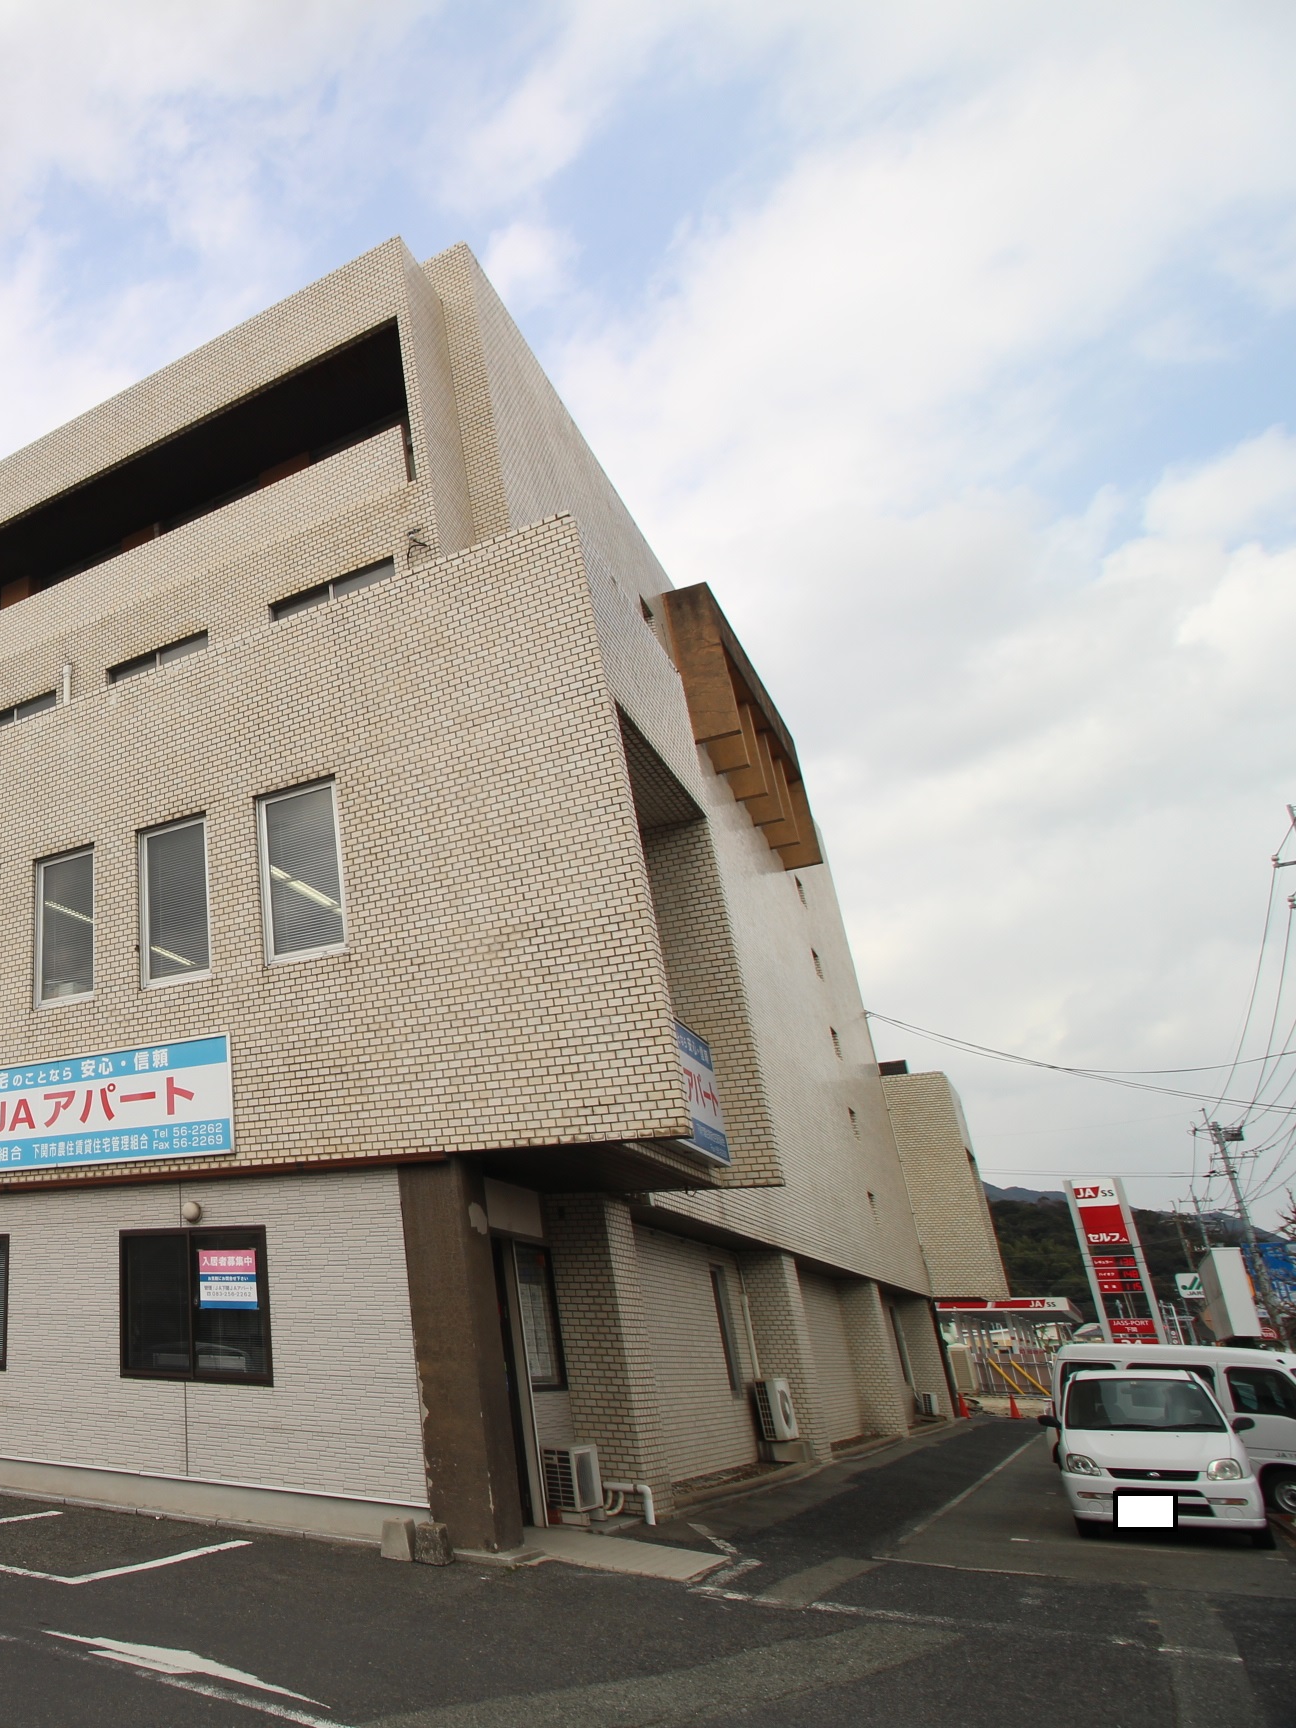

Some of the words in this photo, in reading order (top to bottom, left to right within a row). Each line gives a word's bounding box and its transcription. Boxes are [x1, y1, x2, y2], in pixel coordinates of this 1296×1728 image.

[81, 1048, 169, 1079] 安心・信頼
[683, 1067, 719, 1117] アパート
[153, 1128, 168, 1139] Tel
[172, 1122, 223, 1138] 56-2262
[153, 1140, 170, 1150] Fax
[172, 1134, 223, 1149] 56-2269
[1077, 1188, 1096, 1198] JA
[1100, 1189, 1114, 1197] SS
[1087, 1232, 1120, 1243] セルフ
[202, 1256, 253, 1267] 入居者募集中
[1029, 1300, 1043, 1308] JA
